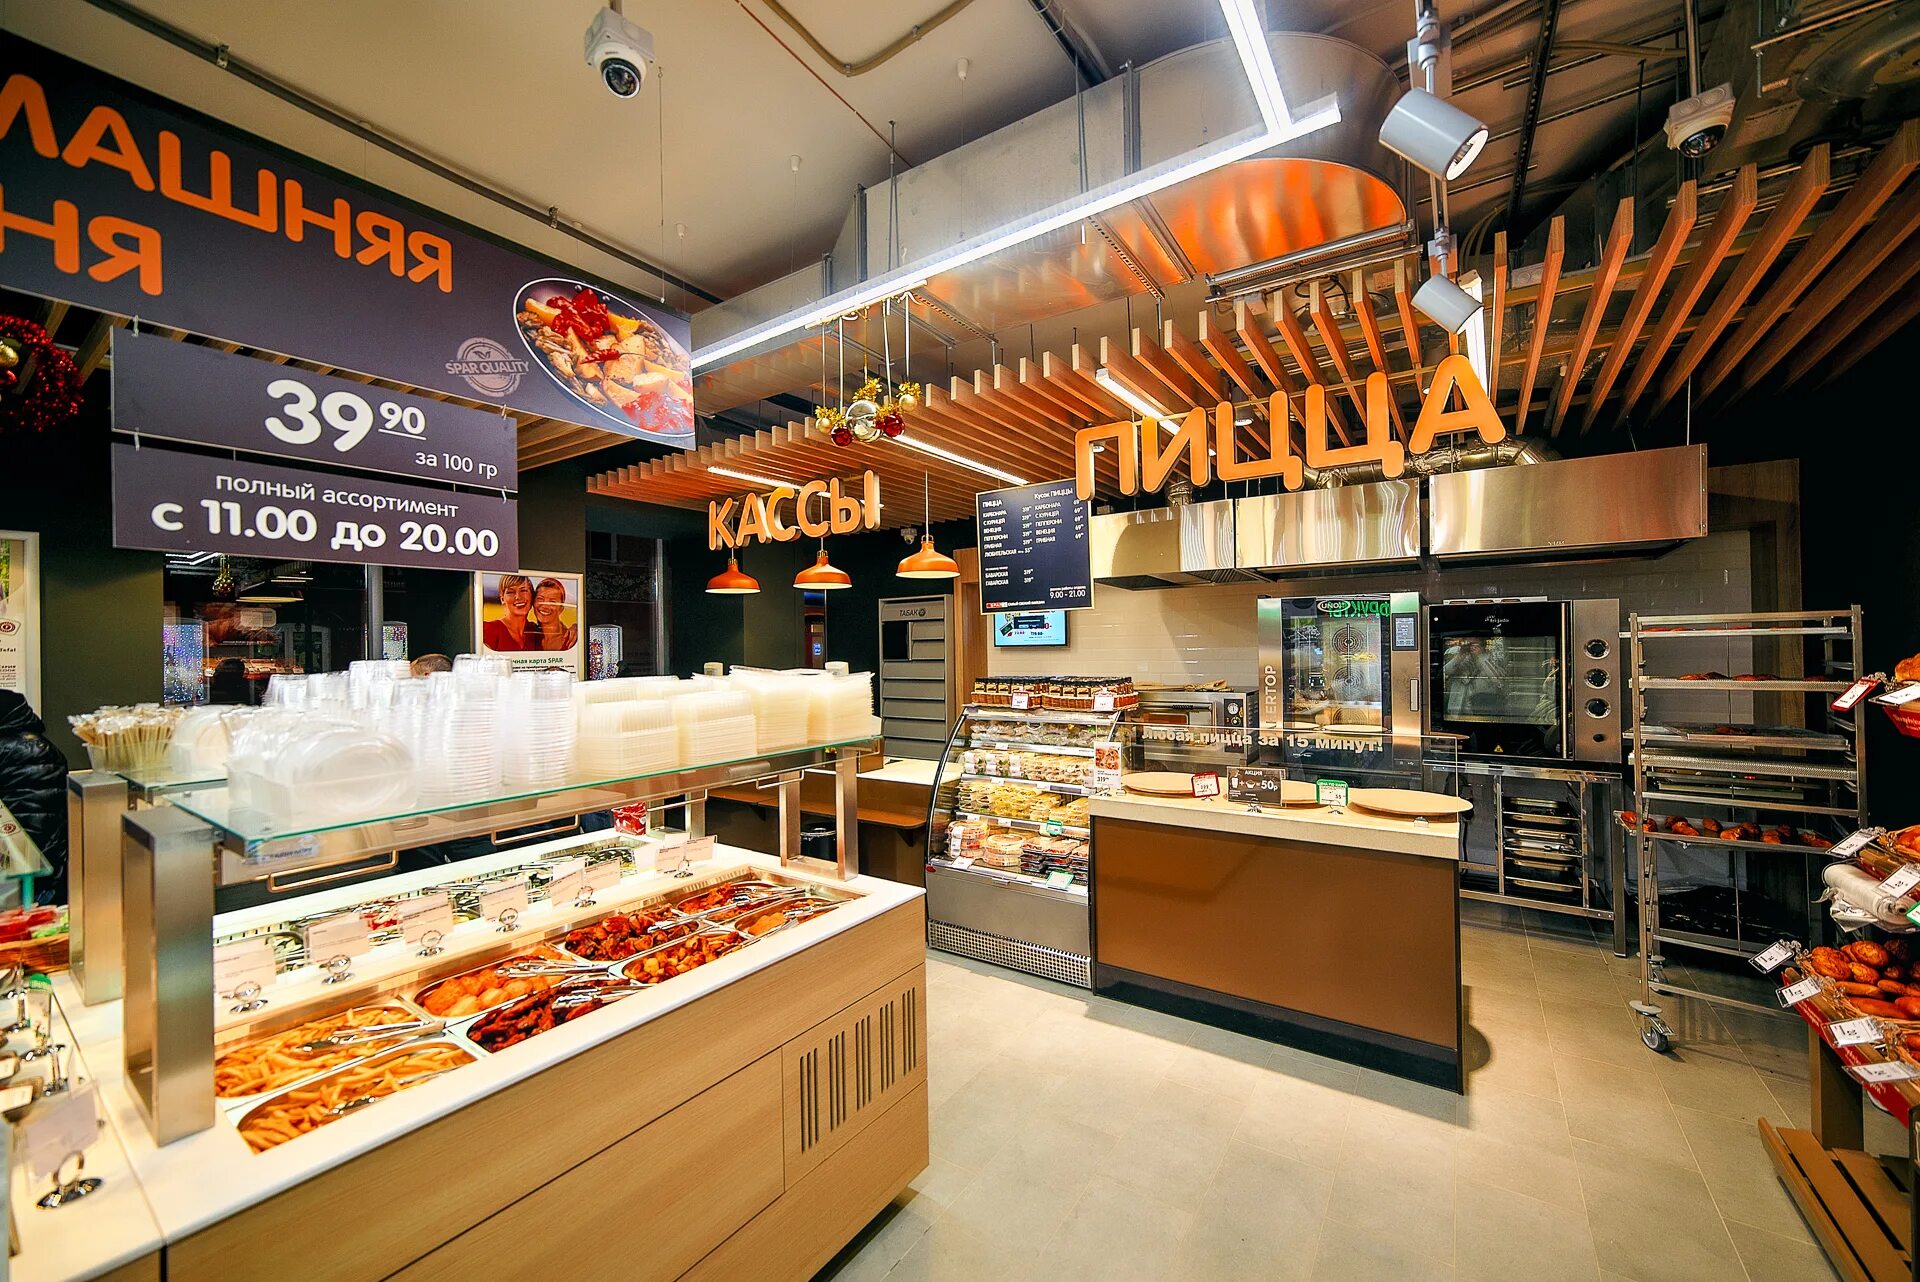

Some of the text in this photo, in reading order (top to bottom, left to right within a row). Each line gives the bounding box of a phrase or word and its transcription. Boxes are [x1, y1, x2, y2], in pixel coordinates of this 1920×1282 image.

[445, 361, 530, 375] SPAR QUALITY
[1075, 355, 1507, 500] ПИЦЦА
[415, 451, 499, 480] за 100 гр
[216, 473, 460, 519] полный ассортимент
[982, 499, 1003, 508] ПИЦЦА
[1034, 502, 1061, 510] КАРБОНАРА
[709, 469, 878, 551] КАССЫ
[150, 498, 500, 558] с 11.00 до 20.00
[1035, 518, 1062, 527] ПЕППЕРОНИ
[1050, 591, 1064, 599] 9.00
[1068, 589, 1086, 598] 21.00
[899, 608, 918, 617] ТАБАК
[1142, 728, 1384, 754] Любая пицца за 15 минут!
